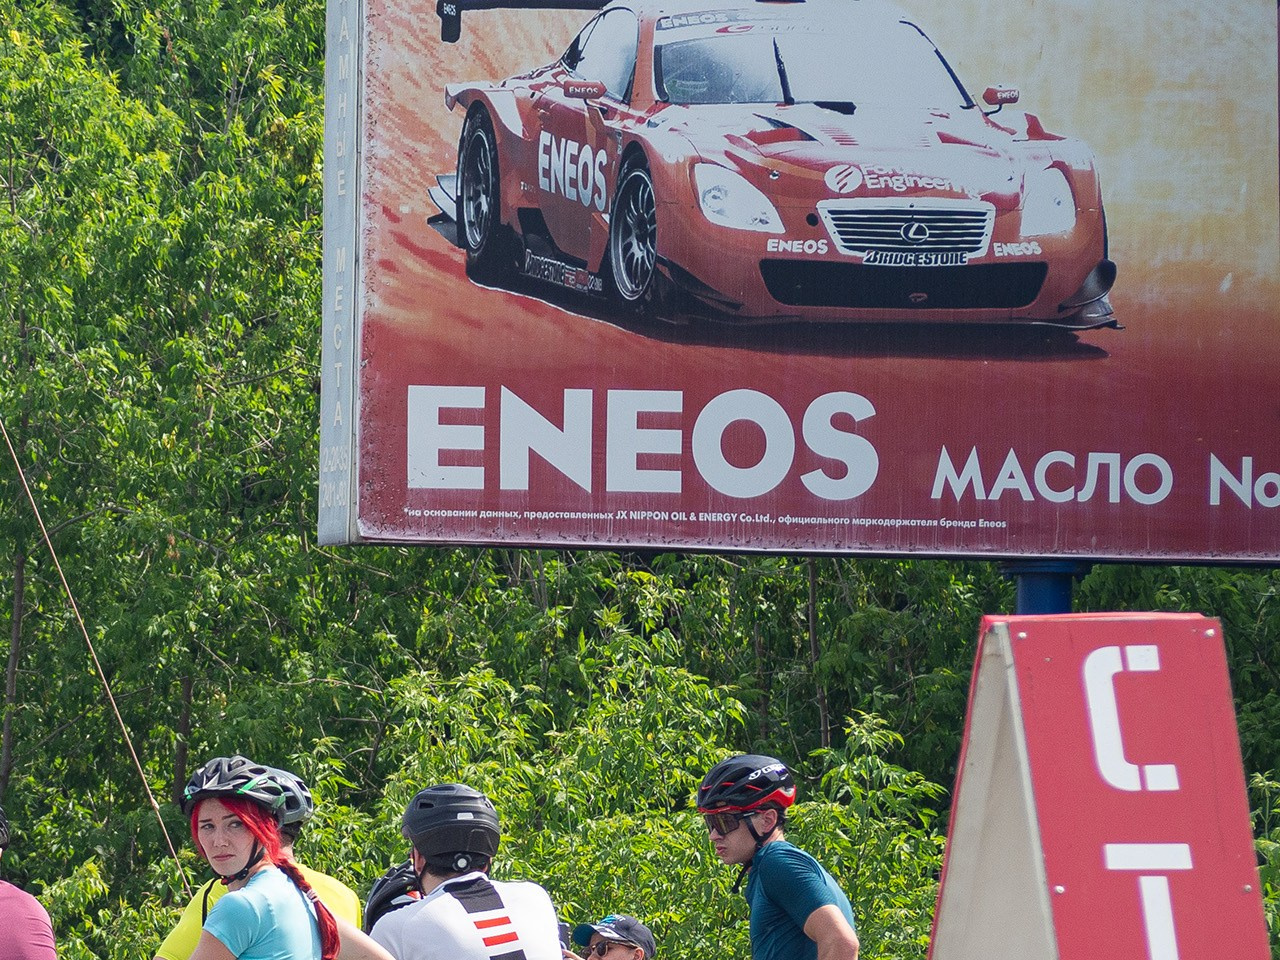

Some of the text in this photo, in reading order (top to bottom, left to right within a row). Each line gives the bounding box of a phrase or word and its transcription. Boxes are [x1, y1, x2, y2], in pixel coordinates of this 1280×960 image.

[660, 12, 729, 29] ENEOS
[569, 85, 599, 94] ENEOS
[538, 130, 608, 212] ENEOS
[332, 0, 350, 427] АМНЫЕ МЕСТА
[766, 239, 829, 254] ENEOS
[992, 241, 1043, 258] ENEOS
[862, 250, 969, 267] BRIDGESTONE
[406, 384, 879, 502] ENEOS
[930, 443, 1174, 506] МАСЛО
[423, 508, 478, 518] основании
[480, 509, 522, 519] данных,
[523, 510, 614, 520] предоставленных
[615, 510, 628, 520] JX
[629, 511, 669, 521] NIPPON
[671, 511, 687, 521] OIL
[689, 512, 696, 521] &
[699, 512, 738, 522] ENERGY
[778, 515, 850, 526] официального
[852, 517, 938, 527] маркодержателя
[940, 517, 977, 528] бренда
[978, 518, 1007, 528] Eneos
